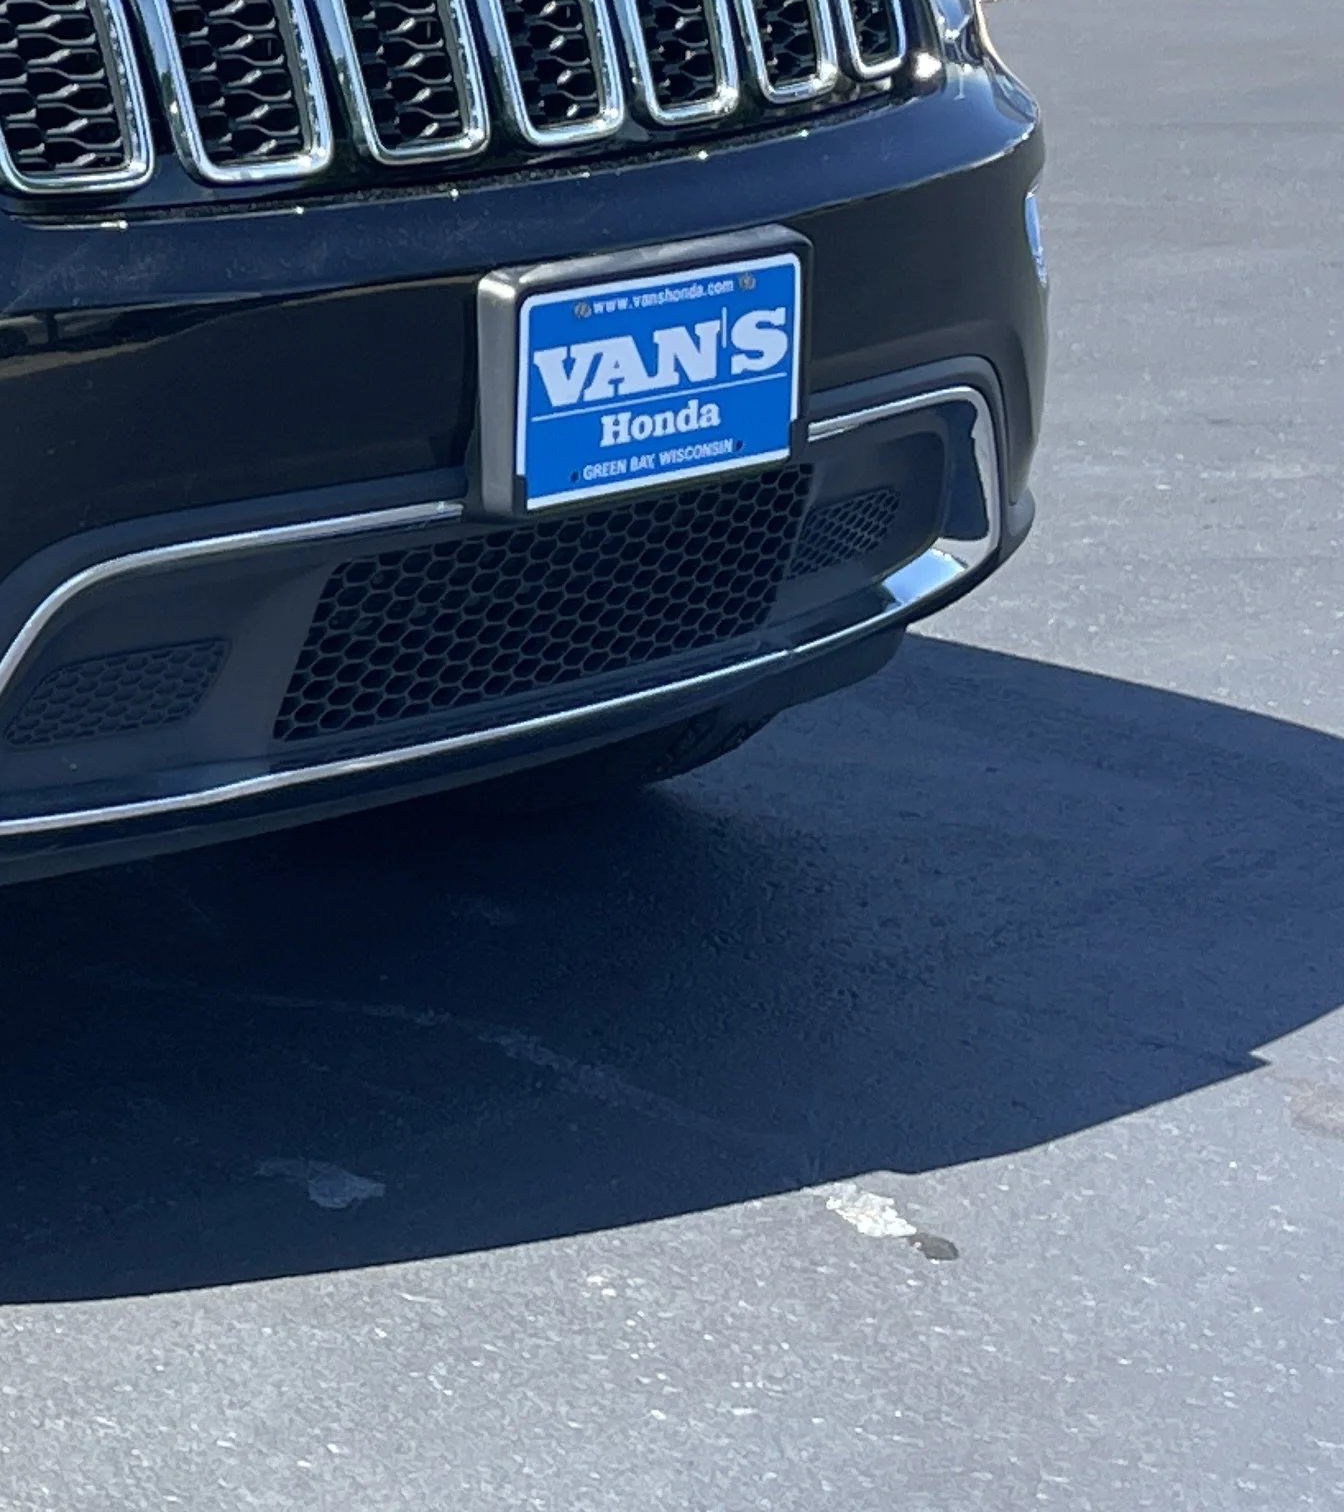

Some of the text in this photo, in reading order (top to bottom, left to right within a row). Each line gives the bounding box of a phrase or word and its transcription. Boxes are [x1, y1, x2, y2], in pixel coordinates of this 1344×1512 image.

[593, 280, 734, 315] www.vanshonda.com
[533, 306, 789, 407] VAN'S
[599, 399, 721, 448] Honda
[582, 459, 628, 481] GREEN
[658, 438, 734, 466] WISCONSIN
